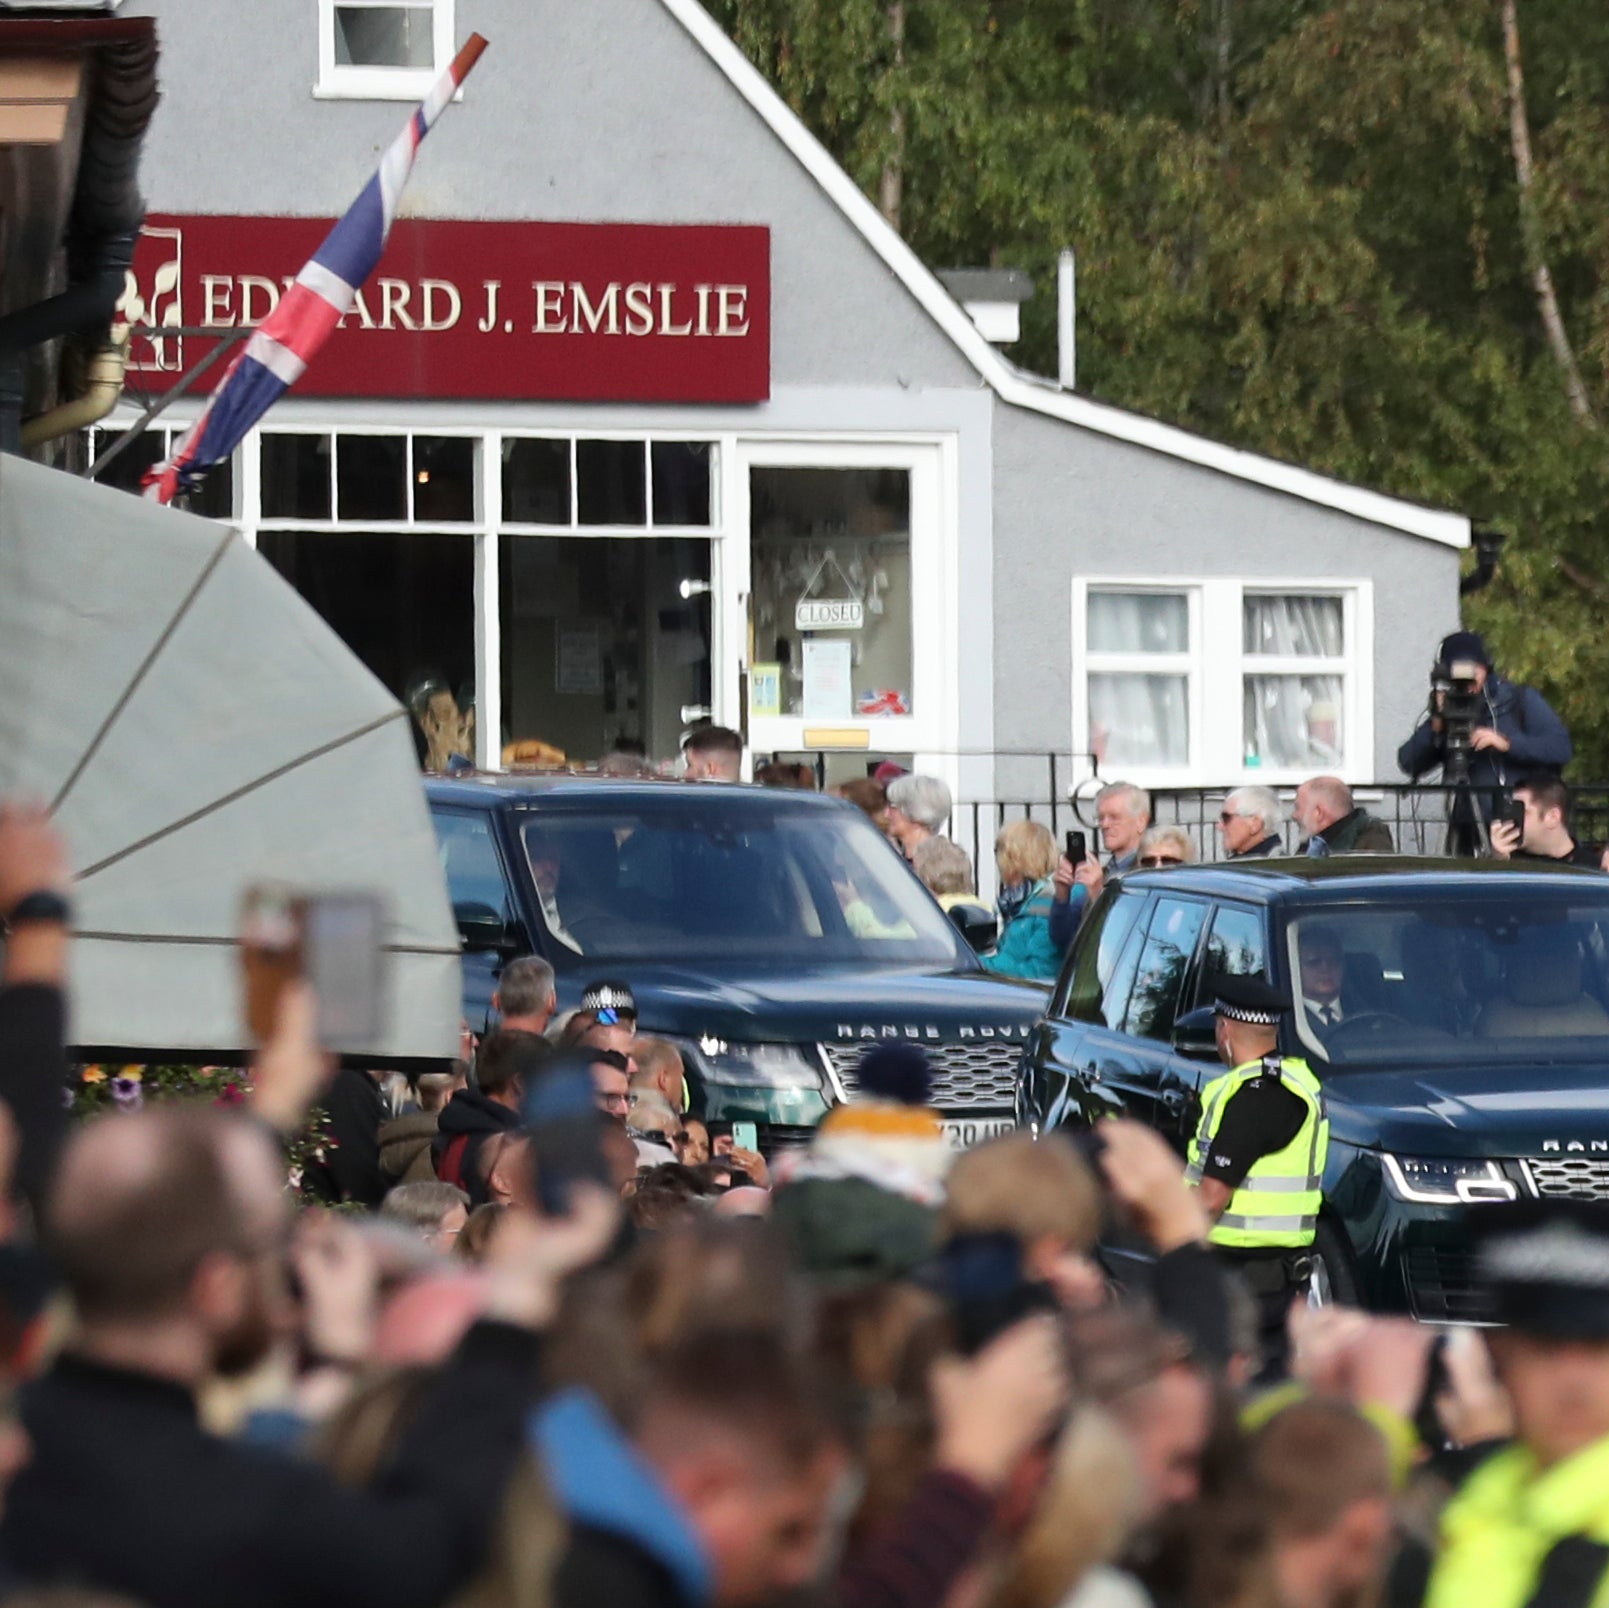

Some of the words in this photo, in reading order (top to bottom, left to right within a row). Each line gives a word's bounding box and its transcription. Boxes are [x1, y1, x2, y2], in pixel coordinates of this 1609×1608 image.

[199, 274, 462, 332] EDARD
[478, 279, 513, 334] J.
[531, 280, 751, 337] EMSLIE
[798, 603, 861, 623] CLOSED
[836, 1023, 941, 1039] RANGE
